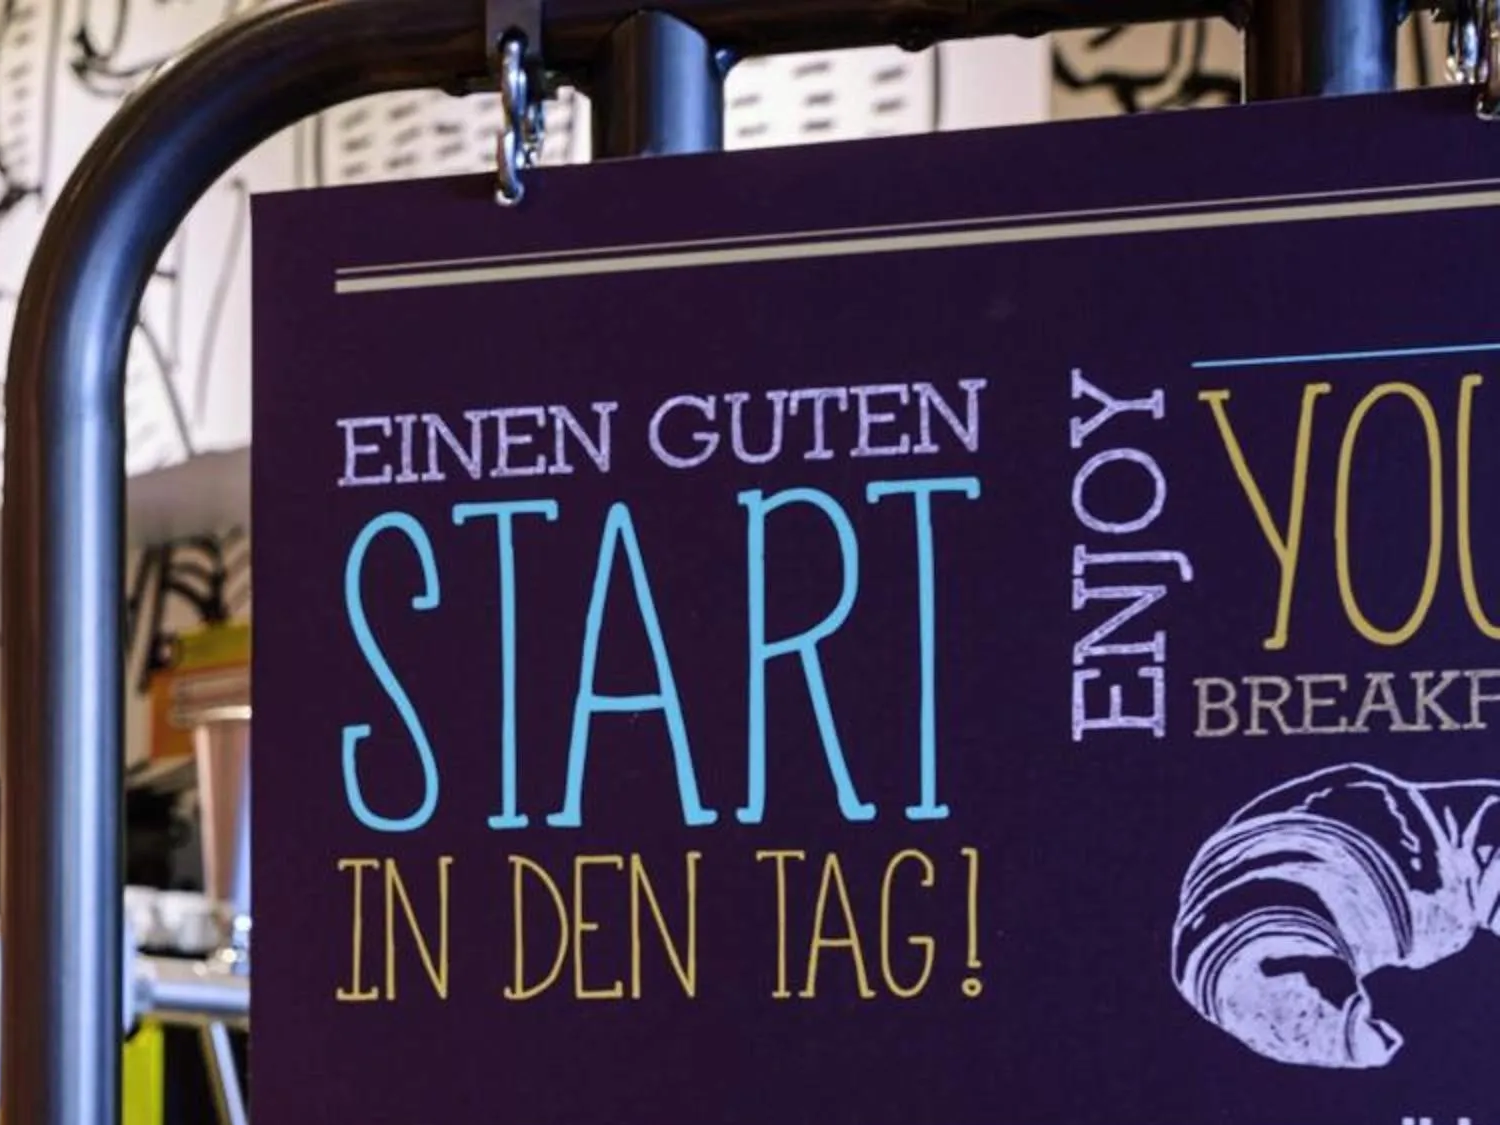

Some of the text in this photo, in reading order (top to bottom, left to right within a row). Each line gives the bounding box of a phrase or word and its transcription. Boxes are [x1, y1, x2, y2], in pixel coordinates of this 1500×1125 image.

[336, 378, 988, 487] EINEN GUTEN
[1070, 367, 1194, 742] ENJOY
[342, 477, 981, 831] START
[1193, 668, 1500, 737] BREAKF
[336, 847, 983, 1001] IN DEN TAG!
